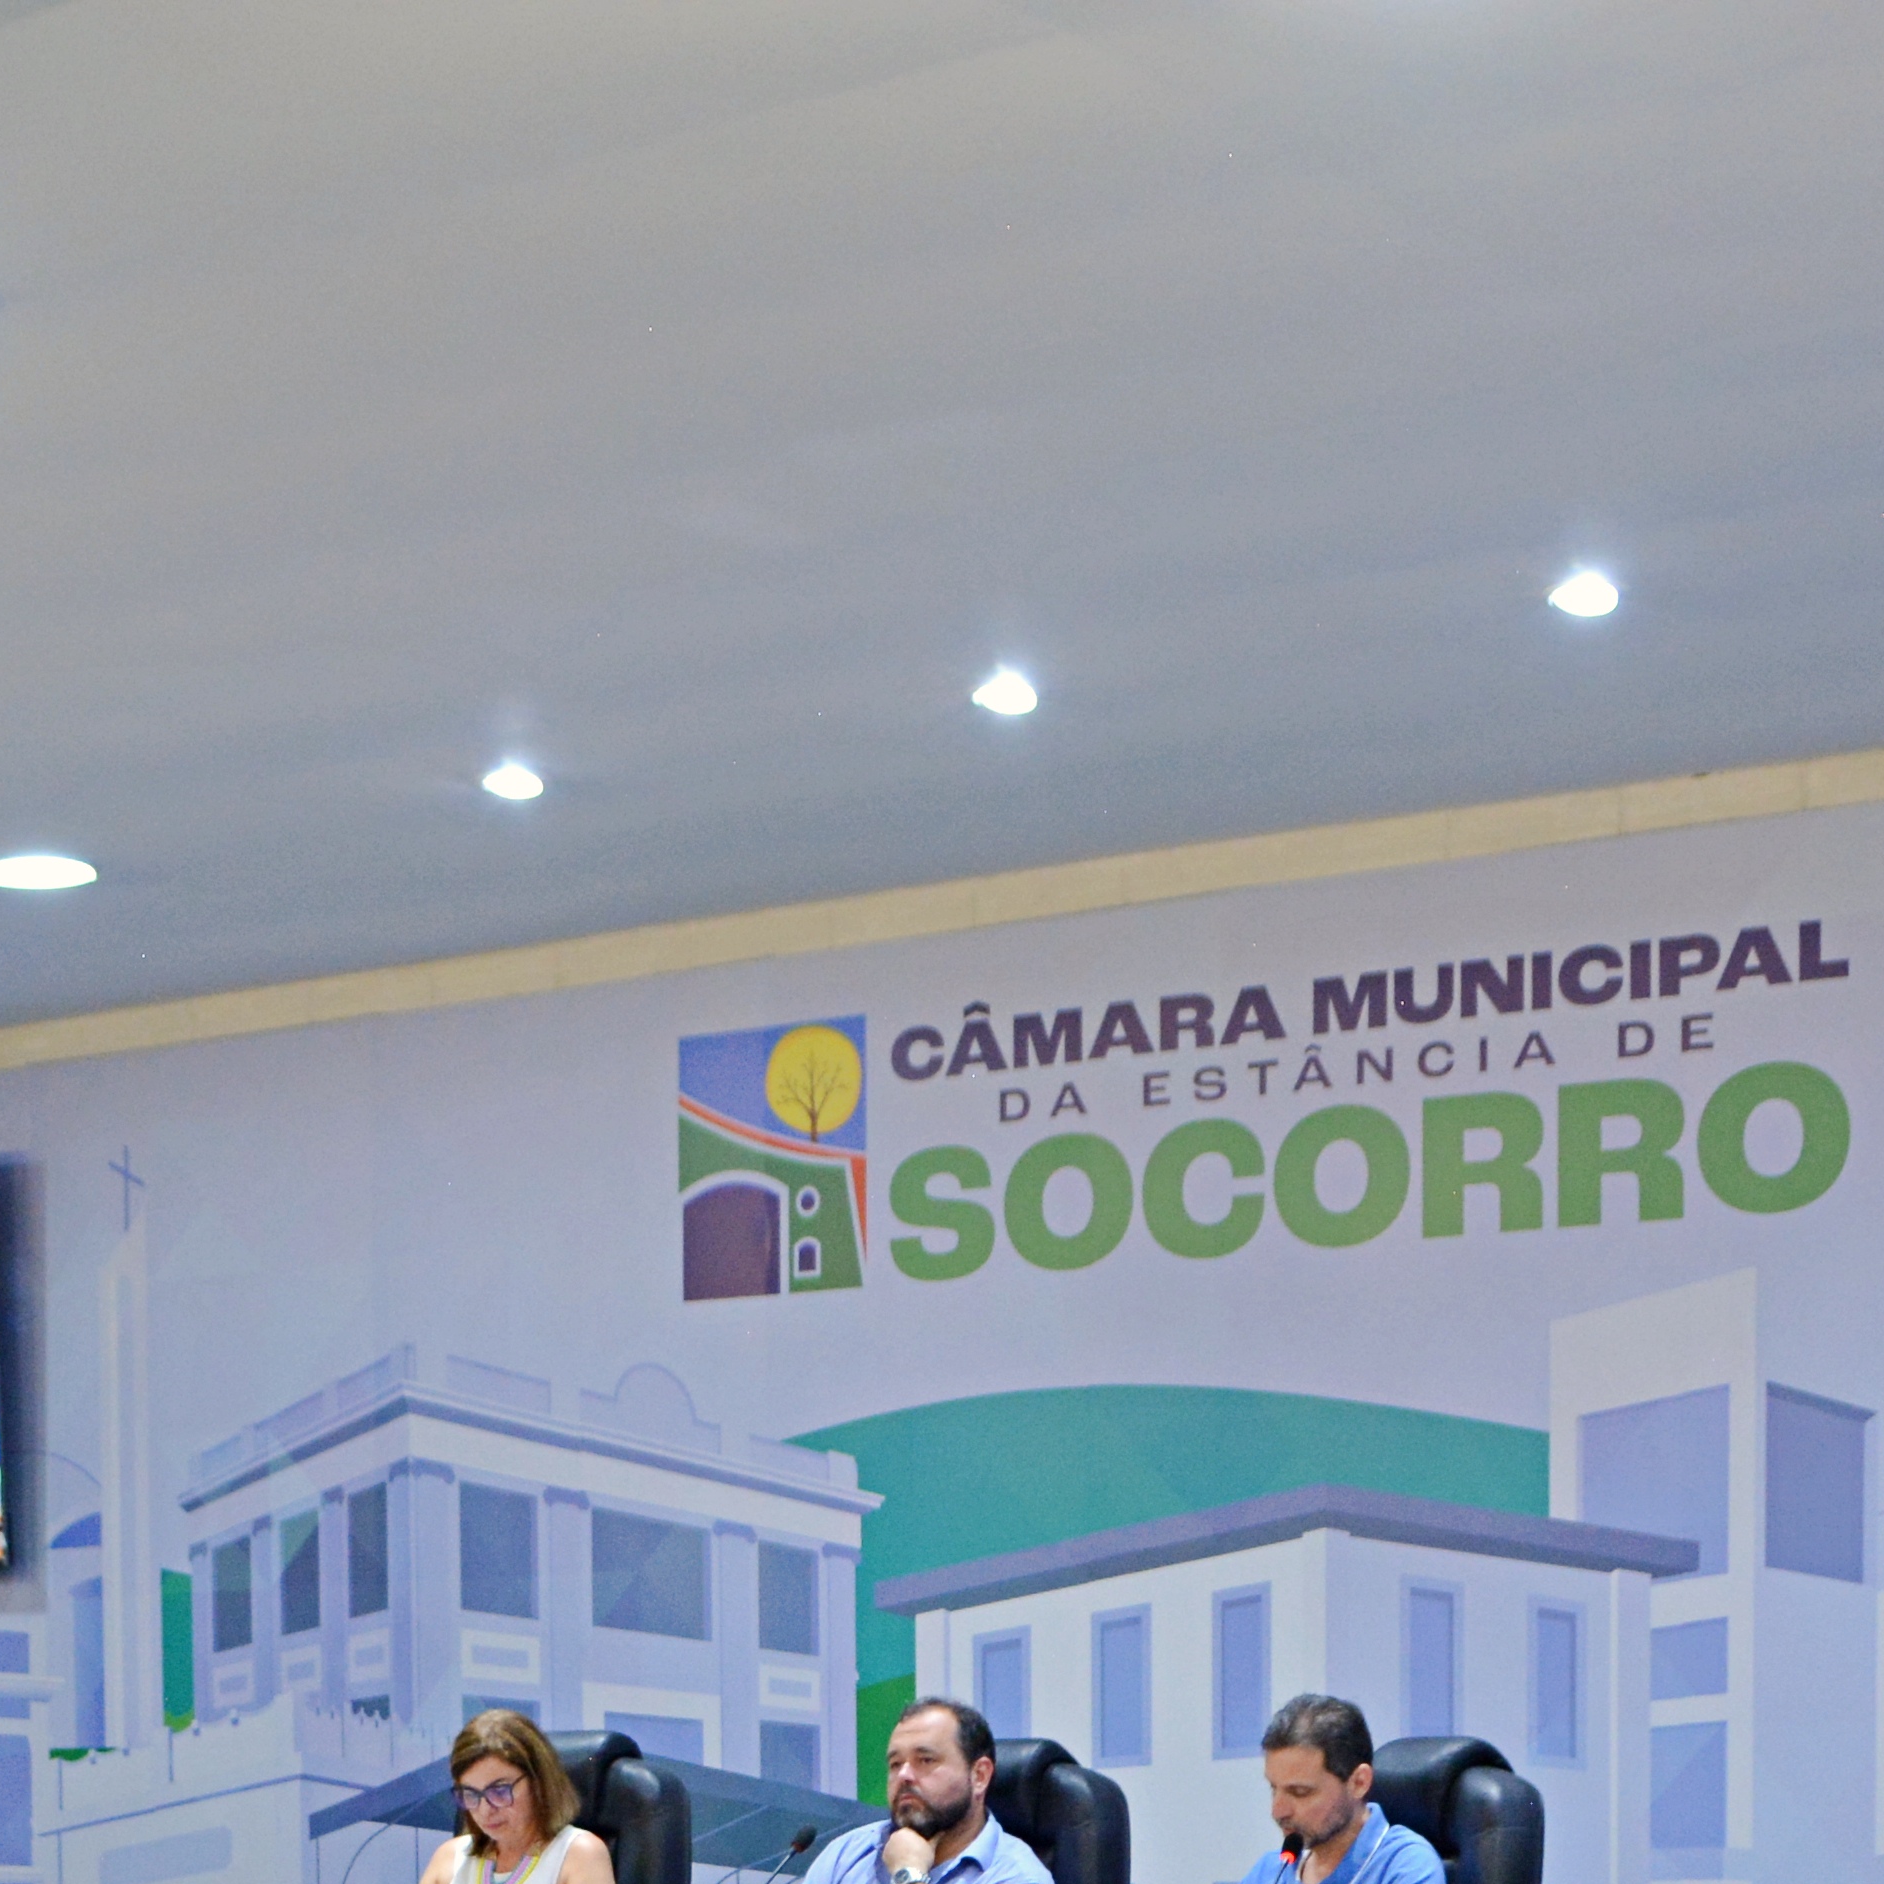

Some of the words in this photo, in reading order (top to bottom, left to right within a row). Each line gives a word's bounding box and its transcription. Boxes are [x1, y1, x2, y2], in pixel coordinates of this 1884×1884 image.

[890, 983, 1287, 1082] CÂMARA
[1312, 919, 1851, 1036] MUNICIPAL
[998, 1081, 1088, 1123] DA
[1141, 1029, 1557, 1108] ESTÂNCIA
[1617, 1012, 1715, 1059] DE
[888, 1059, 1852, 1282] SOCORRO
